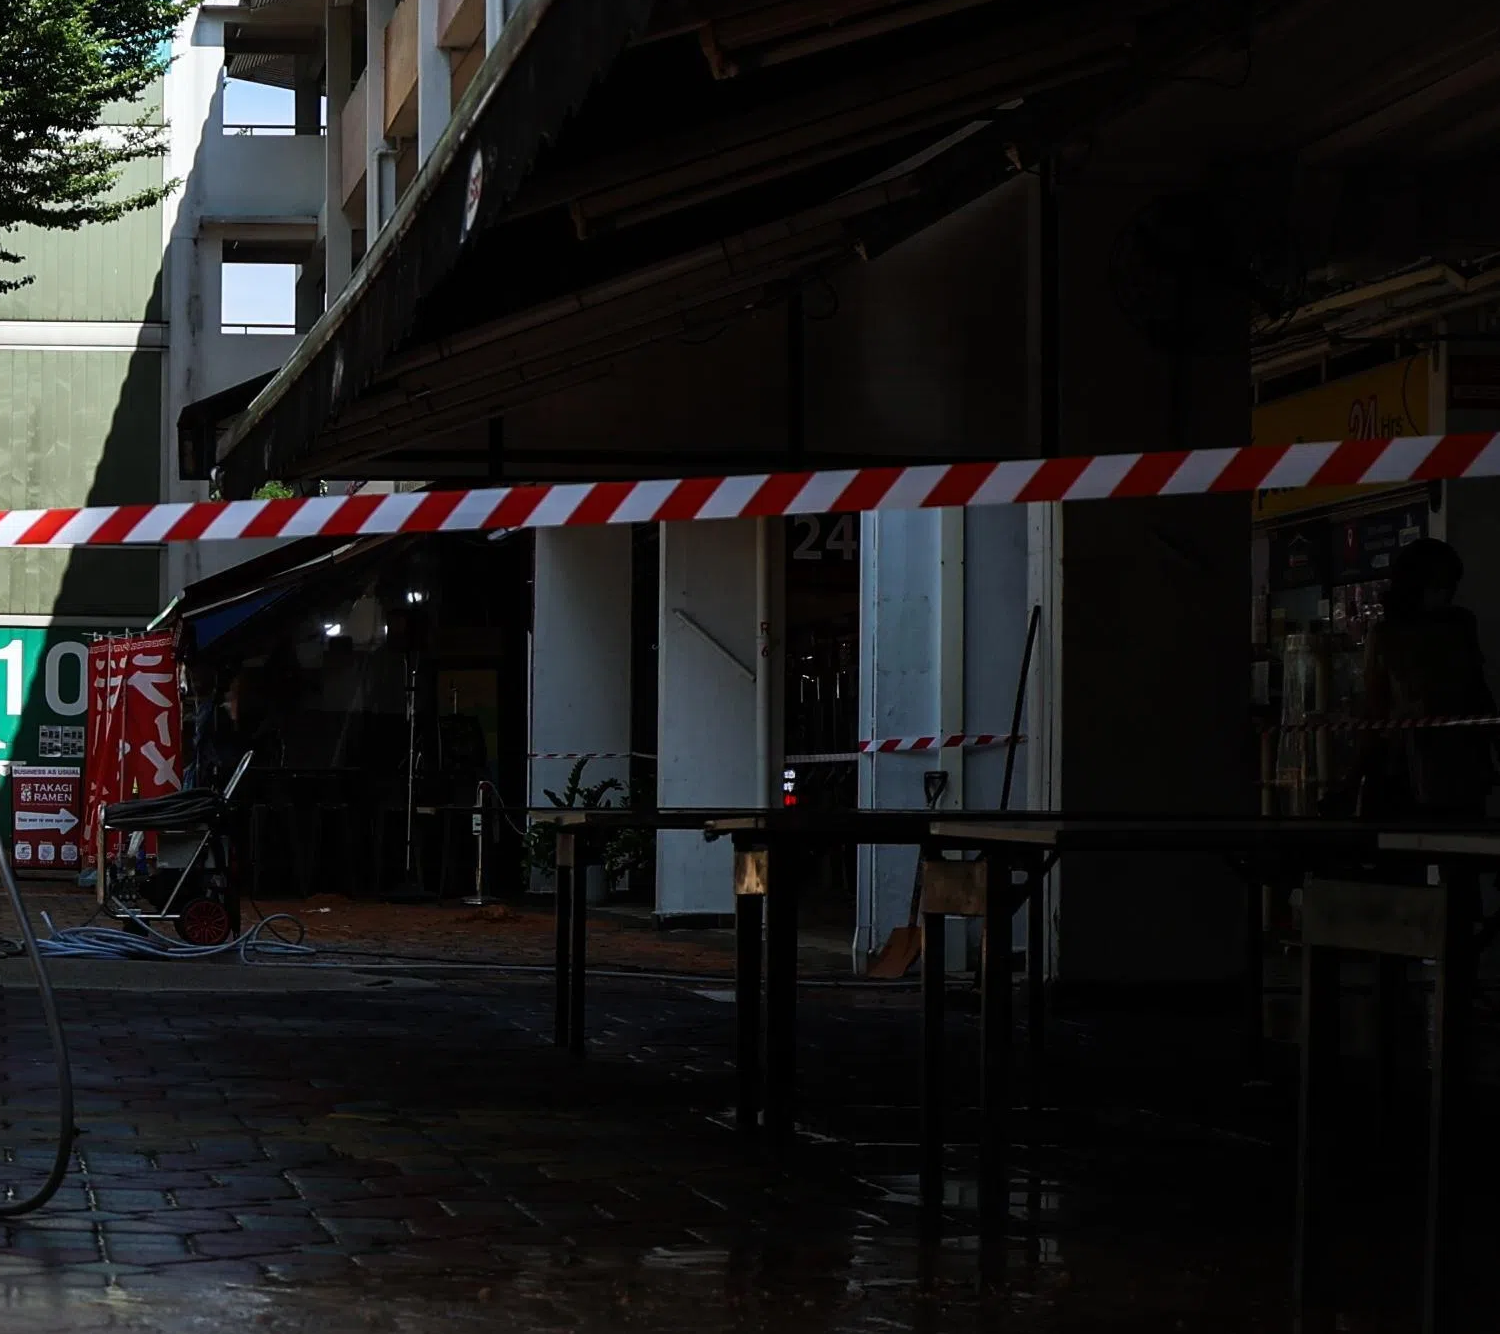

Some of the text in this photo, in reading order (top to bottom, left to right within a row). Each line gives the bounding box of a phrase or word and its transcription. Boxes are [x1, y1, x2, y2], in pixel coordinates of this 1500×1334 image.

[793, 514, 857, 560] 24
[33, 783, 73, 792] TAKAGI
[34, 793, 73, 802] RAMEN
